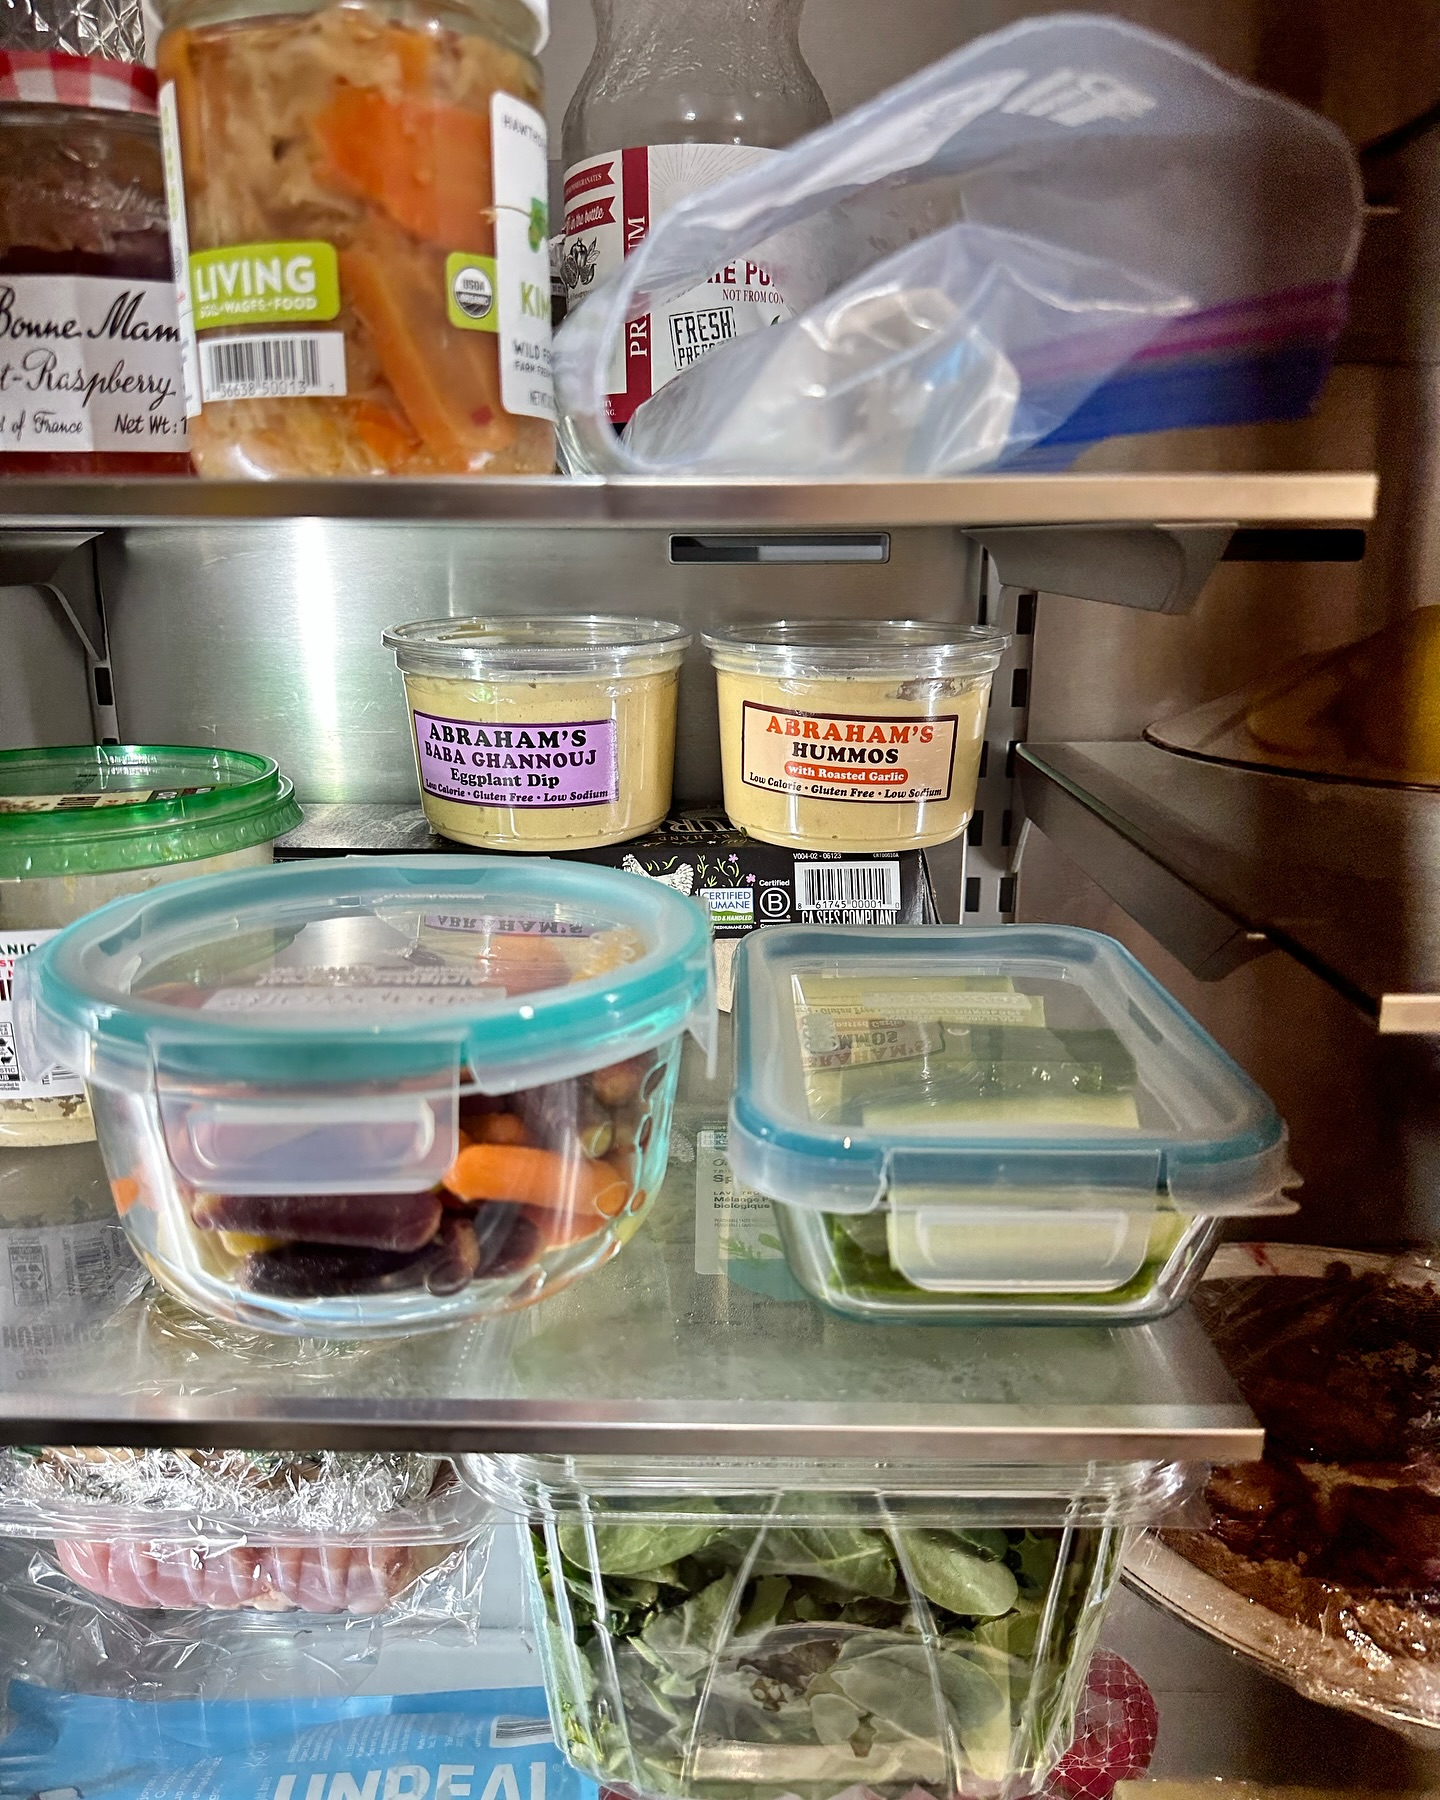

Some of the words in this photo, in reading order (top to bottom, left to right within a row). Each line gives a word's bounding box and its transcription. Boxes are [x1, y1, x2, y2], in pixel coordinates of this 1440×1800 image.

[584, 206, 604, 223] bottle
[196, 256, 316, 302] LIVING
[463, 279, 485, 292] USDA
[722, 289, 742, 301] NOT
[743, 290, 767, 303] FROM
[0, 285, 82, 339] Bonne
[224, 299, 266, 314] WAGES
[274, 298, 318, 311] FOOD
[673, 309, 732, 346] FRESH
[512, 339, 540, 360] WILD
[514, 360, 535, 373] FARM
[219, 382, 257, 398] 36638
[261, 380, 307, 396] 50013
[11, 409, 26, 441] of
[33, 410, 83, 435] France
[114, 414, 145, 434] Net
[429, 722, 587, 749] ABRAHAM'S
[766, 715, 935, 744] ABRAHAM'S
[424, 741, 467, 765] BABA
[471, 750, 597, 769] GHANNOUJ
[791, 741, 900, 764] HUMMOS
[450, 767, 522, 788] Eggplant
[527, 773, 560, 789] Dip
[788, 764, 816, 778] with
[818, 768, 866, 782] Roasted
[868, 770, 905, 782] Garlic
[425, 778, 437, 791] Low
[438, 783, 466, 798] Calorie
[473, 790, 507, 802] Gluten
[509, 792, 534, 803] Free
[543, 792, 568, 803] Low
[569, 789, 609, 802] Sodium
[749, 771, 767, 784] Low
[767, 776, 802, 792] Calorie
[811, 784, 848, 798] Gluten
[850, 787, 875, 798] Free
[884, 788, 907, 799] Low
[908, 786, 943, 798] Sodium
[793, 852, 818, 860] V004-02
[759, 879, 791, 887] Certified
[815, 900, 847, 909] 61745
[851, 900, 883, 909] 00001
[842, 909, 898, 925] COMPLIANT
[713, 1202, 771, 1210] biologique
